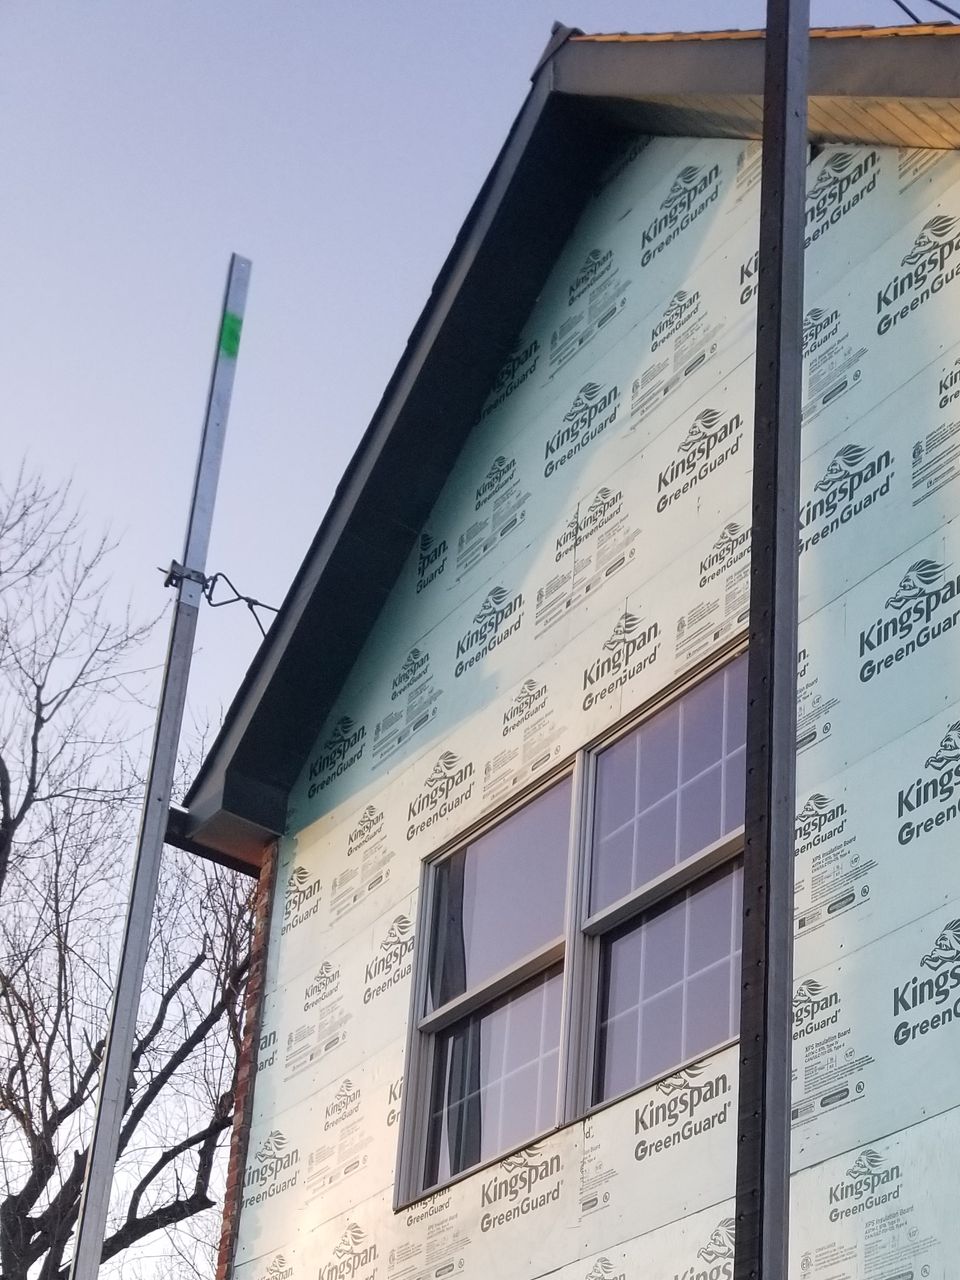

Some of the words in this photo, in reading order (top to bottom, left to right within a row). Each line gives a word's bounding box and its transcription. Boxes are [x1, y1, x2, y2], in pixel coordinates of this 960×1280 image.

[641, 163, 719, 250] Kingspan
[803, 170, 877, 249] eenGuard
[804, 151, 877, 229] ngspan
[640, 184, 720, 268] GreenGuard
[651, 290, 699, 341] Kingspan
[651, 305, 700, 352] GreenGuard
[544, 385, 619, 459] Kingspan
[544, 404, 620, 478] GreenGuard
[656, 435, 743, 513] GreenGuard
[657, 412, 742, 494] Kingspan
[455, 613, 524, 678] GreenGuard
[456, 593, 523, 659] Kingspan
[583, 622, 660, 690] Kingpan
[406, 783, 474, 841] GreenGuard
[407, 761, 474, 822] Kingspan
[794, 803, 845, 841] ngspan
[794, 819, 846, 857] eenGuard
[363, 963, 412, 1004] GreenGua
[364, 941, 415, 984] Kingspa
[635, 1072, 729, 1135] Kingspan
[635, 1103, 729, 1162] GreenGuard
[481, 1153, 561, 1207] Kingspan
[481, 1181, 561, 1233] GreenGuard
[829, 1165, 900, 1205] Kingspan
[829, 1184, 900, 1223] GreenGuard
